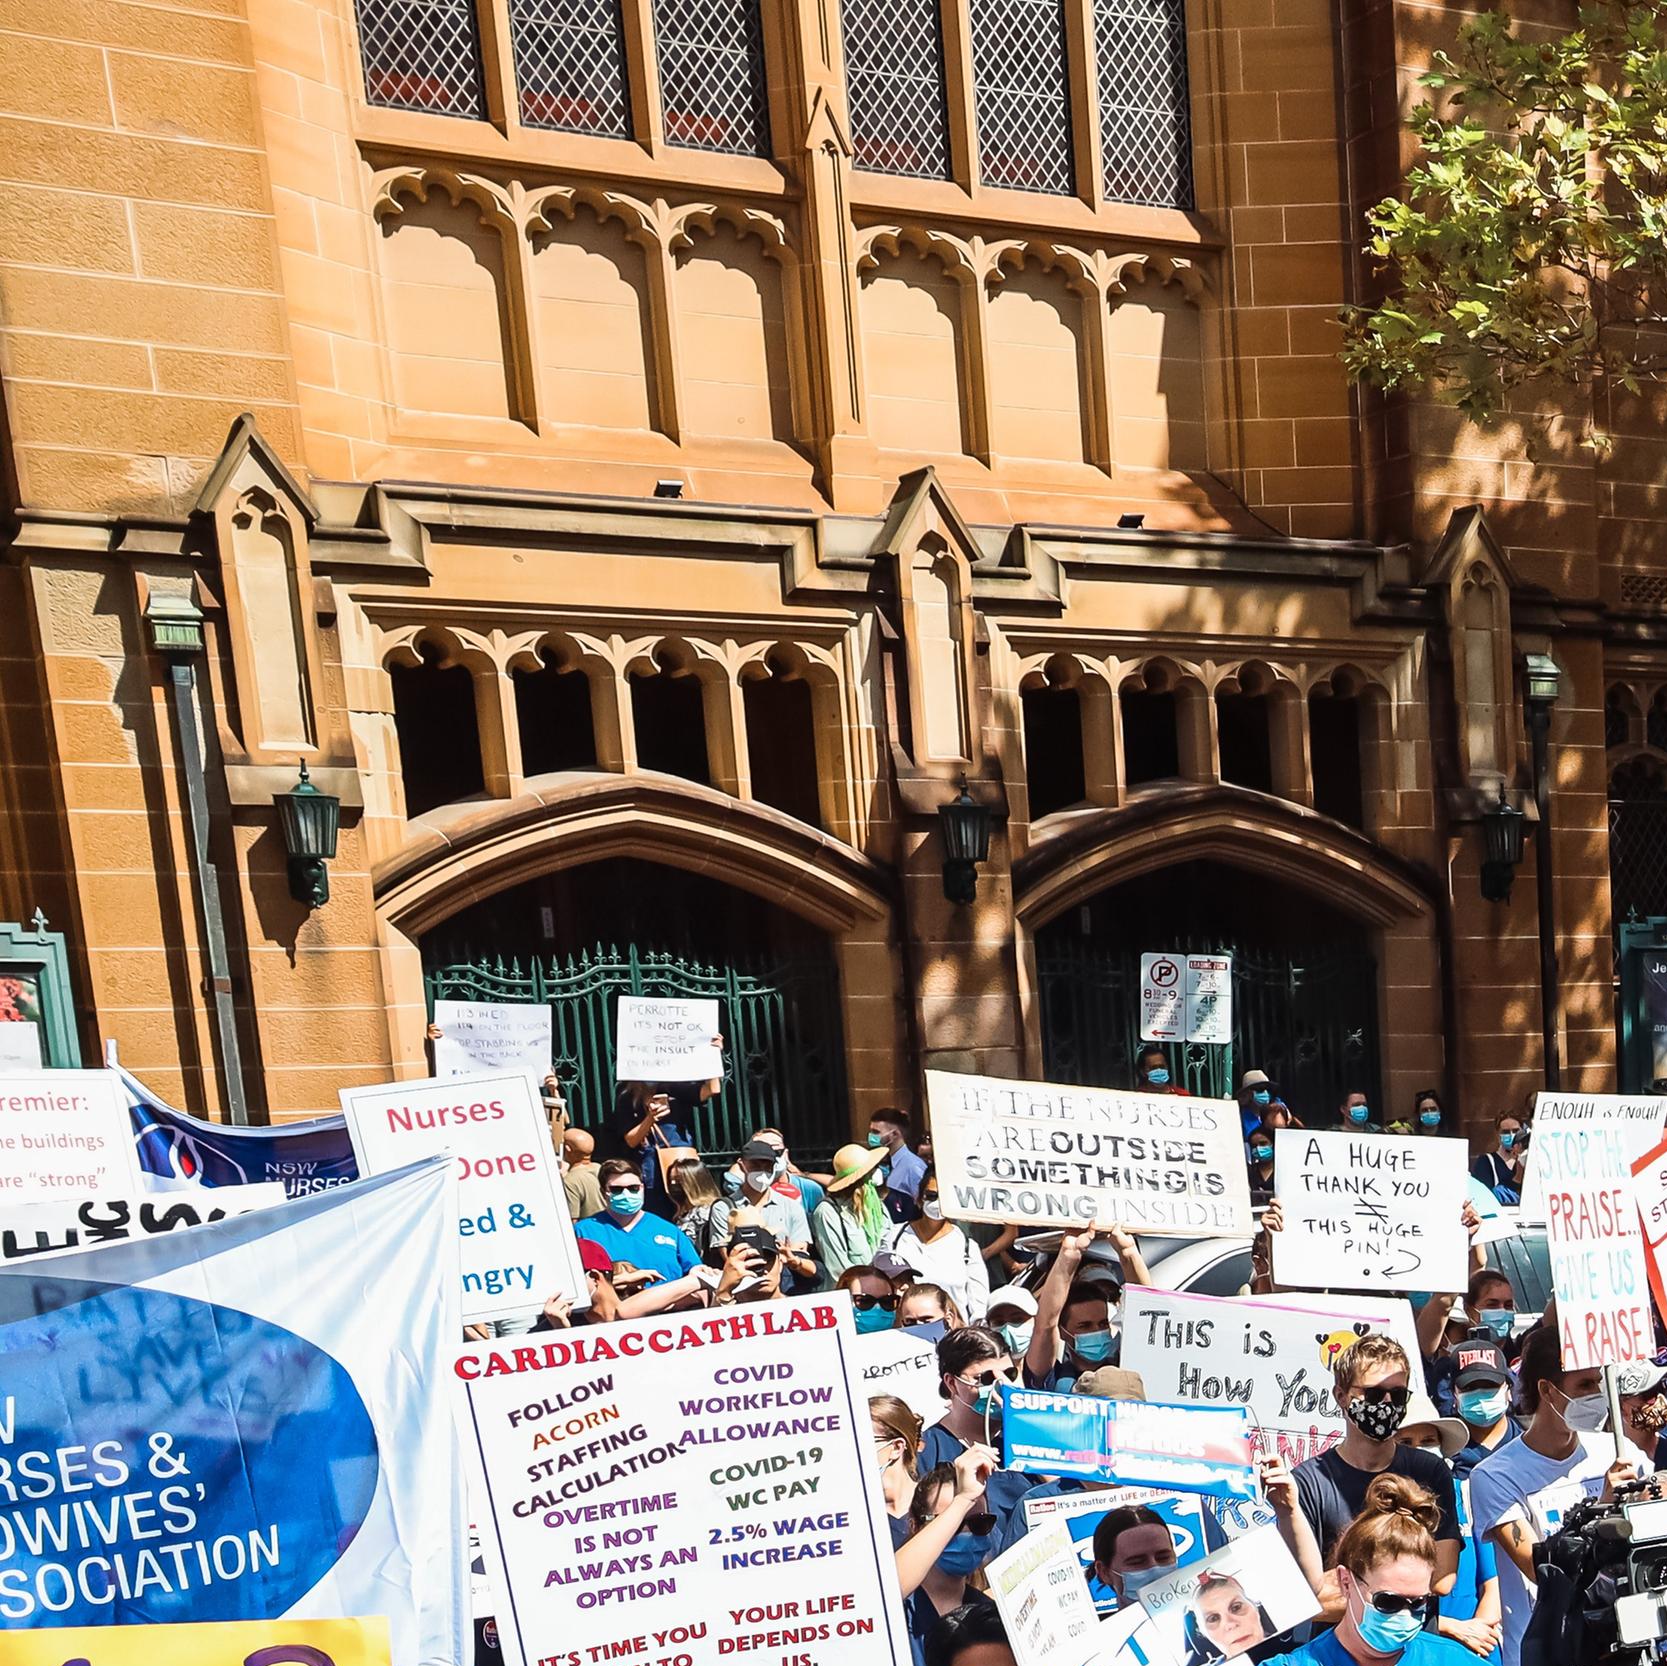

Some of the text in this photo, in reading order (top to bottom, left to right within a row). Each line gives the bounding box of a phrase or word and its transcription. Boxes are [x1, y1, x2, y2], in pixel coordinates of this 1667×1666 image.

[386, 1100, 505, 1132] Nurses
[1000, 1090, 1075, 1120] THE
[976, 1125, 1207, 1165] ARE OUTSIDE
[1350, 1143, 1416, 1172] HUGE
[265, 1162, 317, 1175] NSW
[966, 1156, 1187, 1194] SOMETHING
[953, 1184, 1098, 1218] WRONG
[1300, 1174, 1429, 1198] THANK YOU
[1303, 1219, 1423, 1237] THIS HUGE
[1344, 1239, 1389, 1255] PIN!
[454, 1305, 839, 1381] CARDIAC CATH LAB
[1140, 1309, 1215, 1349] THIS
[1586, 1307, 1656, 1367] RAISE!
[714, 1362, 793, 1386] COVID
[508, 1374, 614, 1429] FOLLOW
[679, 1386, 833, 1417] WORKFLOW
[1010, 1391, 1108, 1415] SUPPORT
[532, 1405, 620, 1451] ACORN
[679, 1415, 841, 1448] ALLOWANCE
[148, 1431, 190, 1479] &
[526, 1424, 648, 1483] STAFFING
[709, 1446, 824, 1486] COVID-19
[543, 1492, 678, 1528] OVERTIME
[708, 1512, 850, 1546] 2.5% WAGE
[544, 1555, 653, 1588] ALWAYS
[722, 1540, 842, 1571] INCREASE
[577, 1578, 677, 1609] OPTION
[729, 1594, 855, 1625] YOUR LIFE
[586, 1635, 648, 1663] TIME
[652, 1622, 707, 1649] YOU
[717, 1623, 832, 1655] DEPENDS
